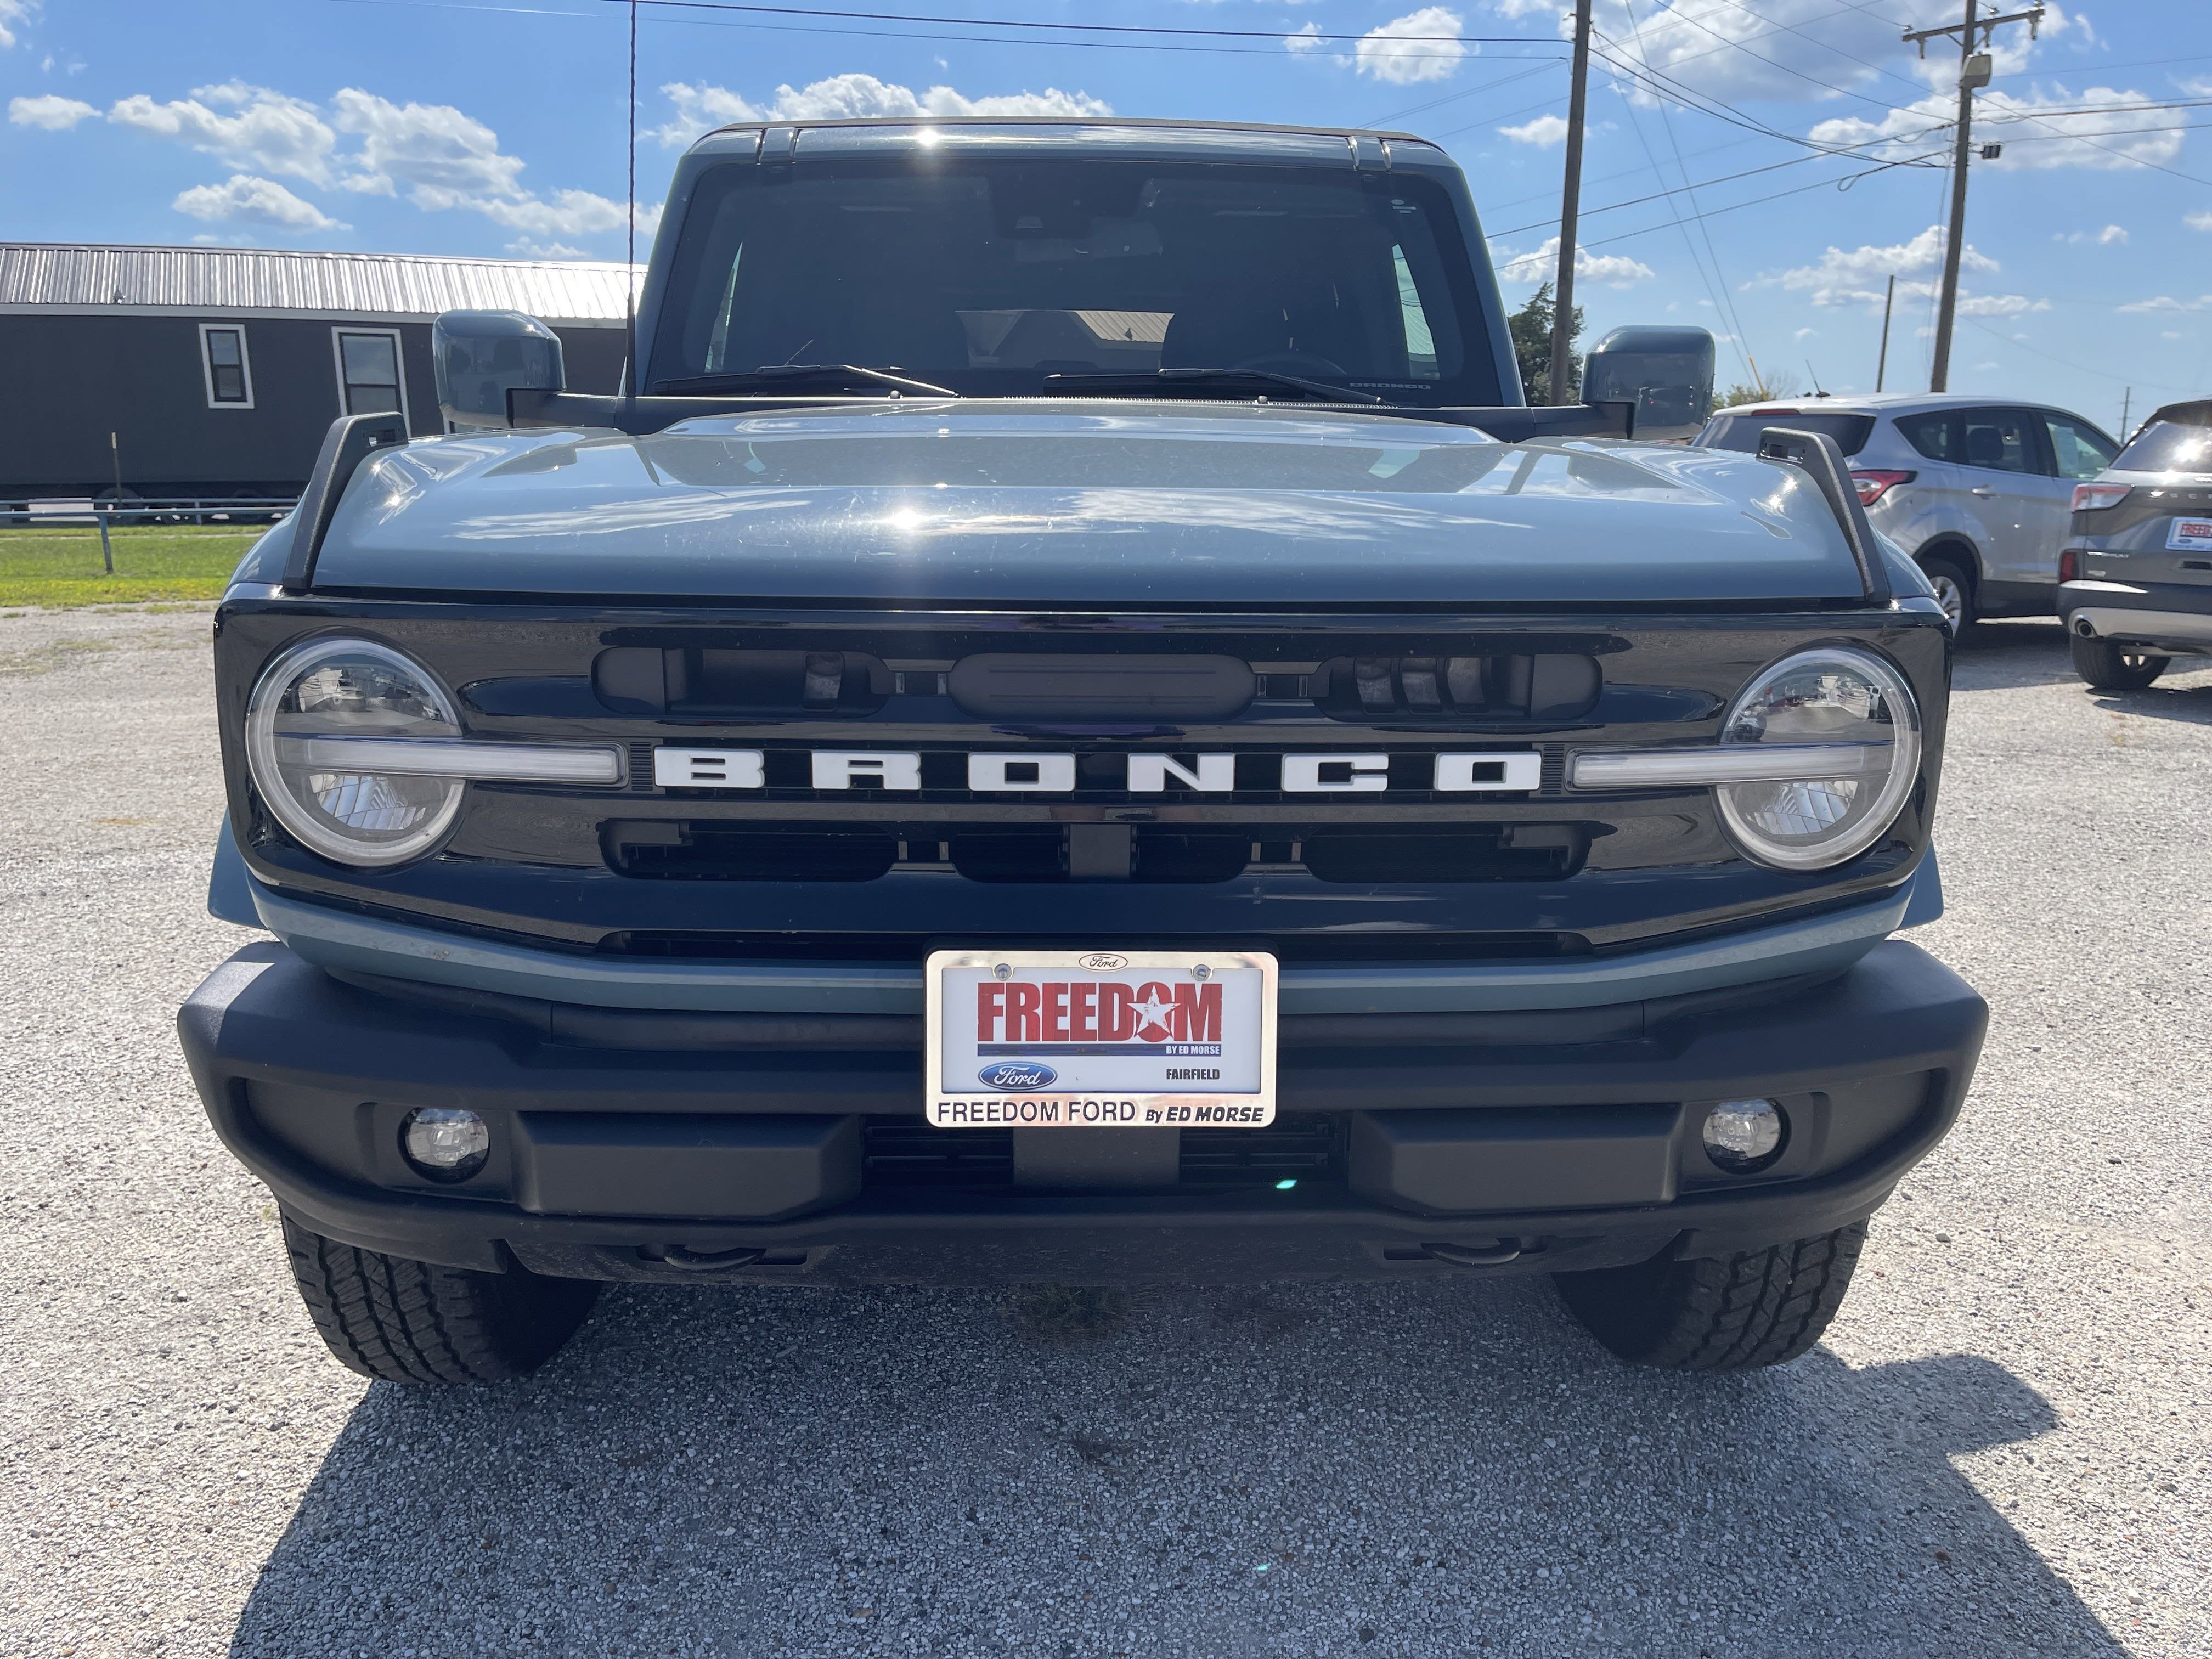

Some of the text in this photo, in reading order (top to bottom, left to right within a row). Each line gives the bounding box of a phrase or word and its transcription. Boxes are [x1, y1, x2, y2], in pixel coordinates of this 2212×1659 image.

[654, 746, 1542, 792] BRONCO
[1090, 956, 1118, 967] Ford
[978, 982, 1222, 1042] FREEDOM
[1166, 1046, 1220, 1054] BY ED MORSE
[994, 1066, 1041, 1085] Ford
[1166, 1069, 1220, 1080] FAIRFIELD
[938, 1101, 1265, 1123] FREEDOM FORD By ED MORSE
